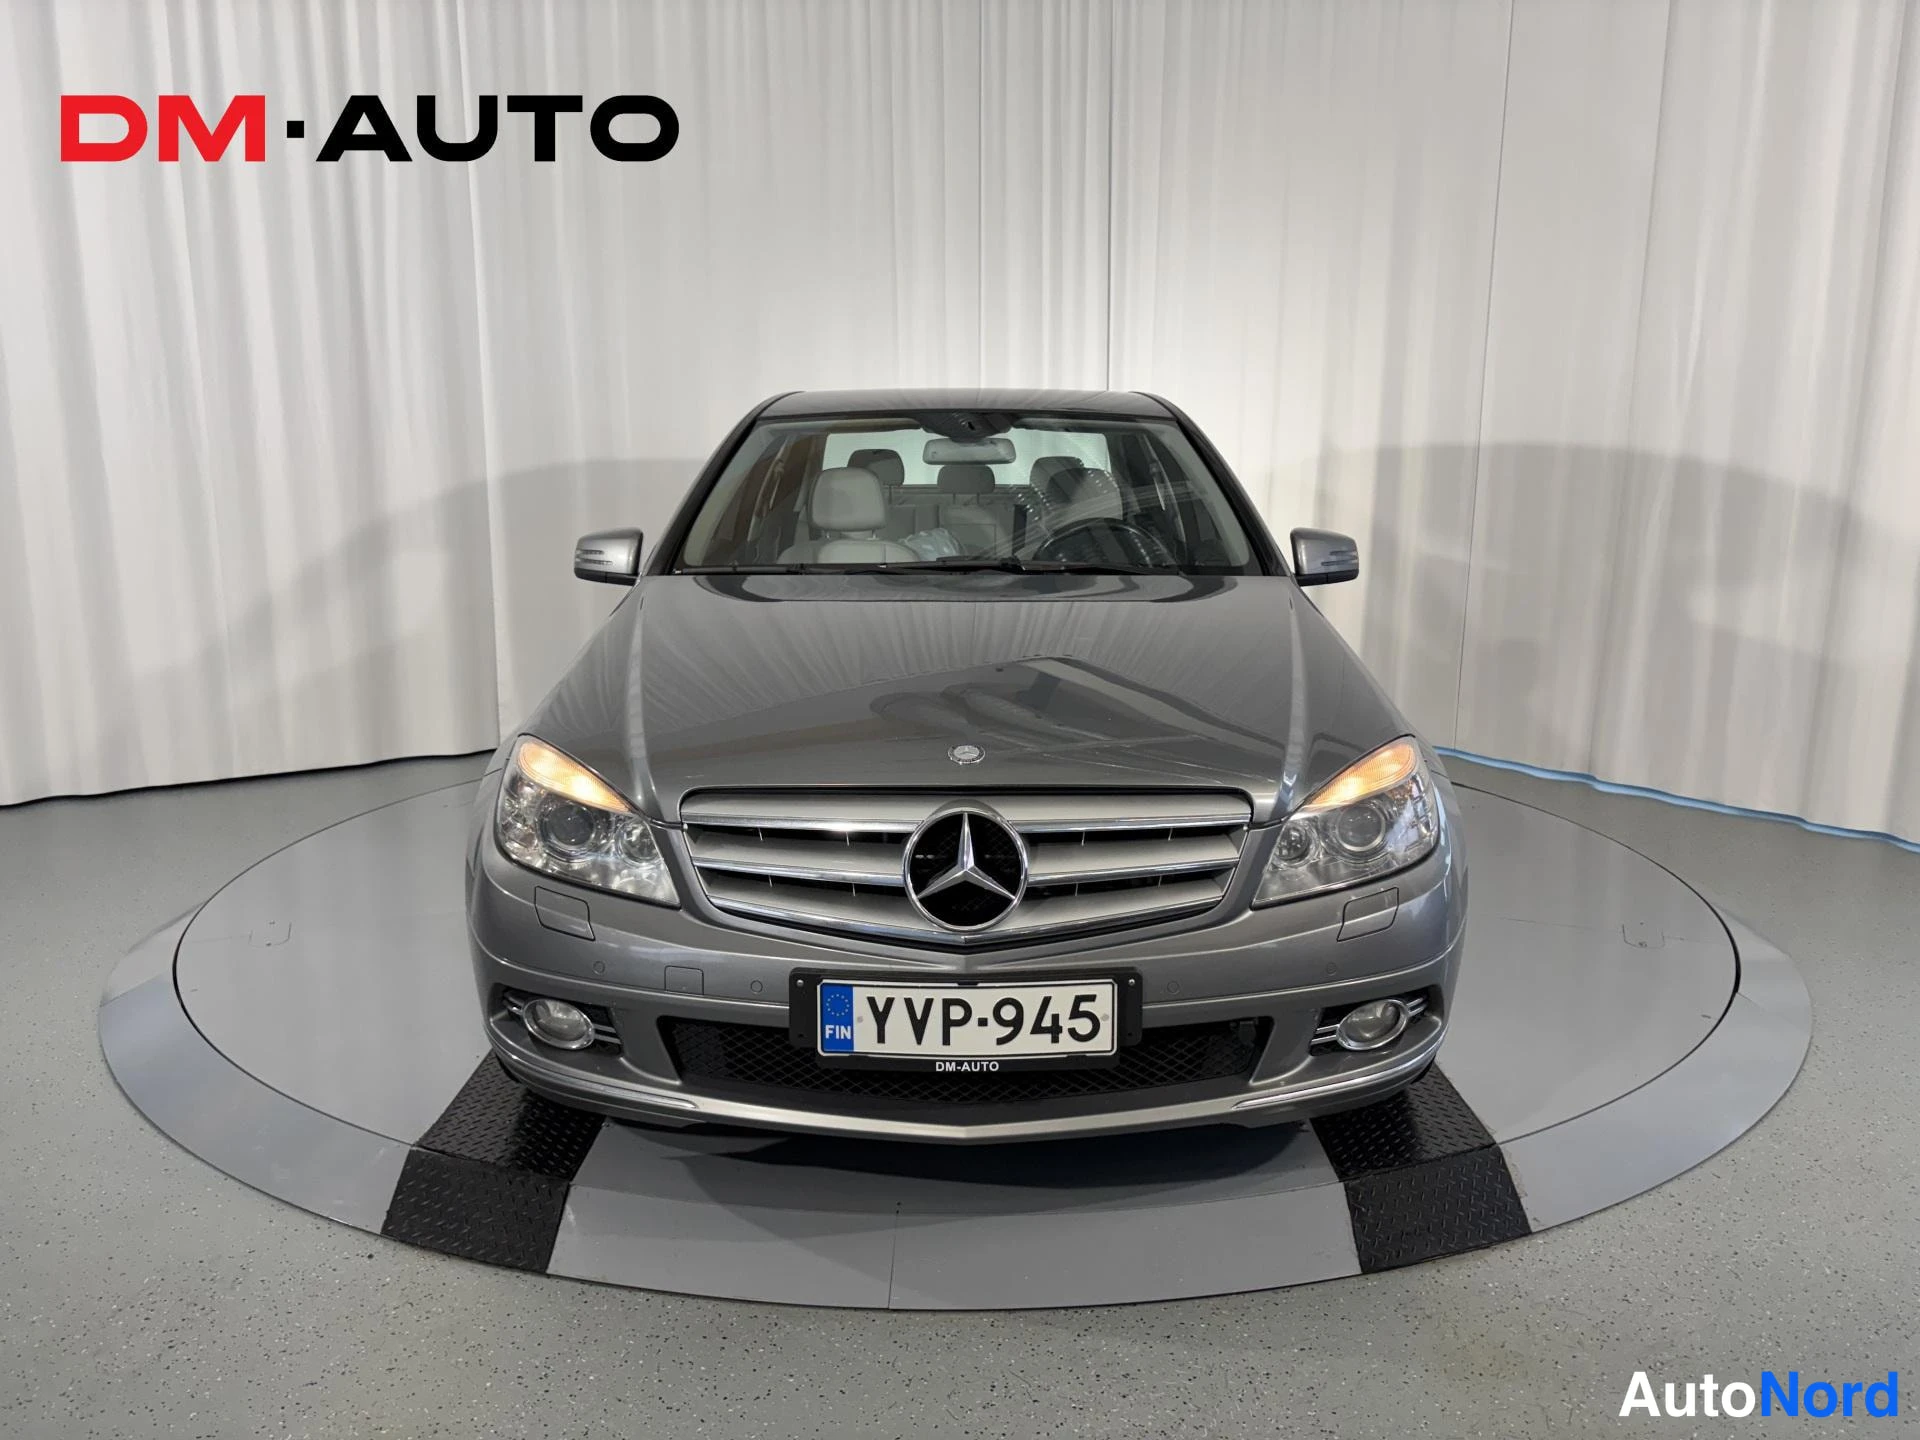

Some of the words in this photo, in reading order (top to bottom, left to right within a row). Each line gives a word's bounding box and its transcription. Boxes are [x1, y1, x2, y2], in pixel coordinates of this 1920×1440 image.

[866, 994, 1101, 1046] YVP-945
[825, 1025, 851, 1040] FIN
[935, 1061, 999, 1073] DM-AUTO
